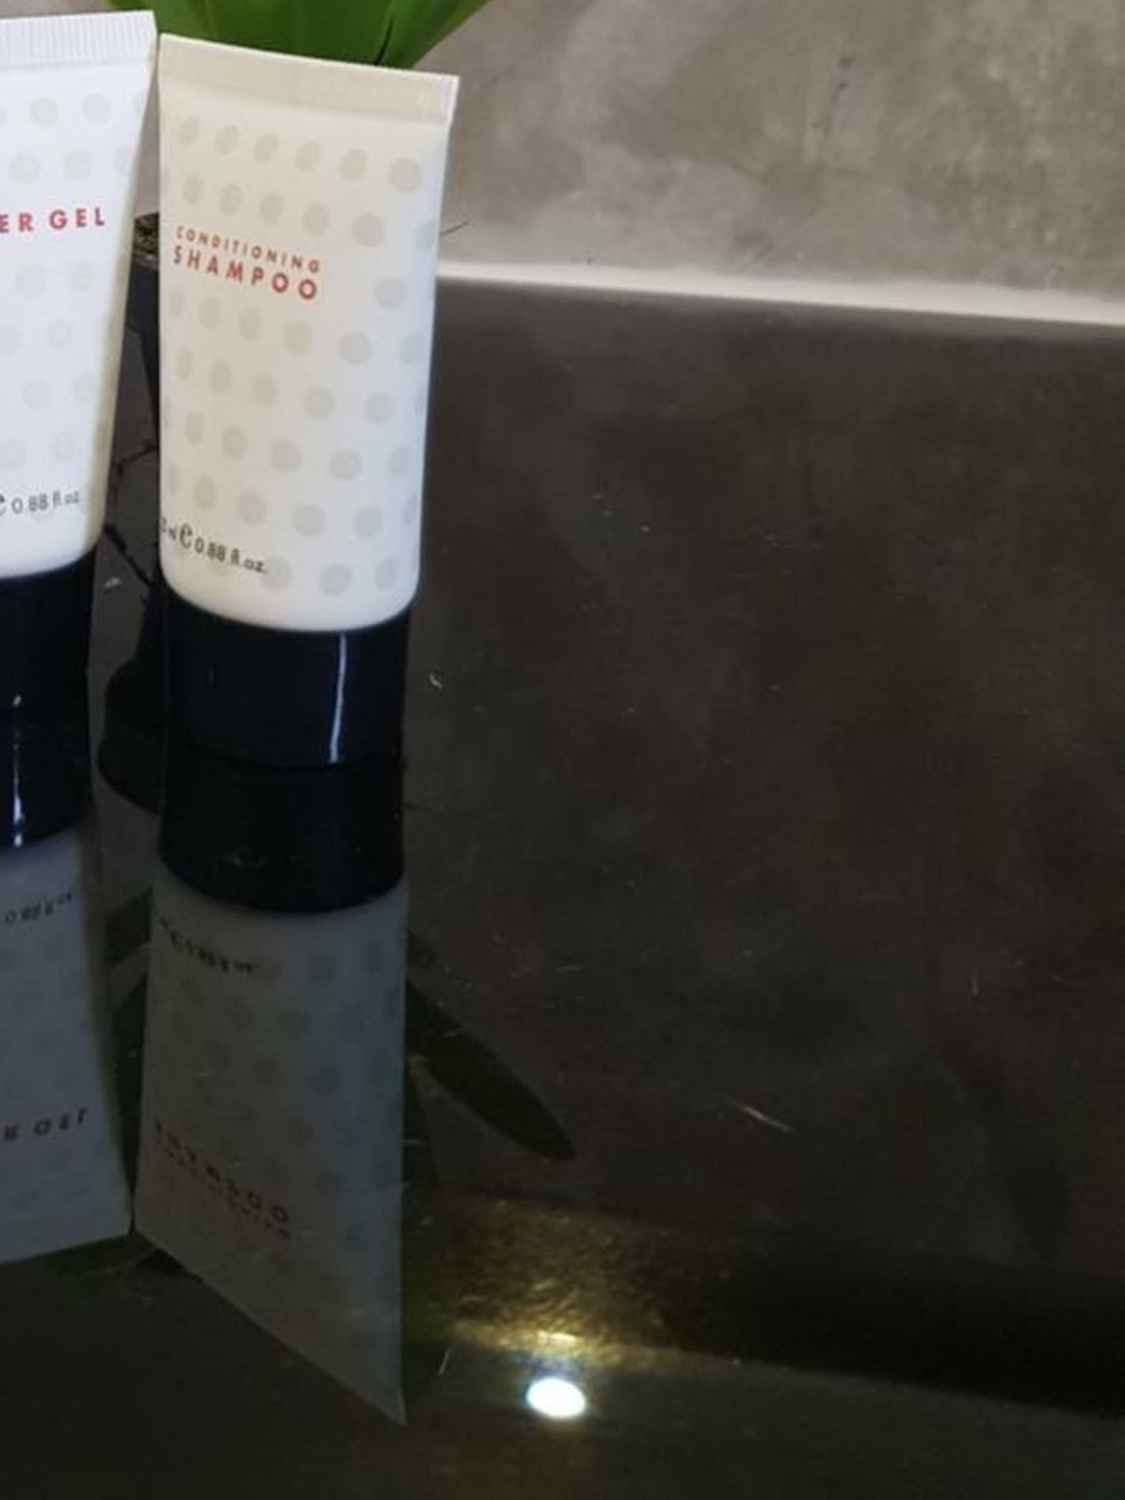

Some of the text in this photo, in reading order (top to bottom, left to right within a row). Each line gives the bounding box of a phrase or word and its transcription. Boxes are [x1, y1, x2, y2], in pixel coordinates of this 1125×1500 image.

[48, 206, 107, 231] GEL
[173, 243, 318, 300] SHAMPOO
[174, 224, 322, 274] CONDITIONING
